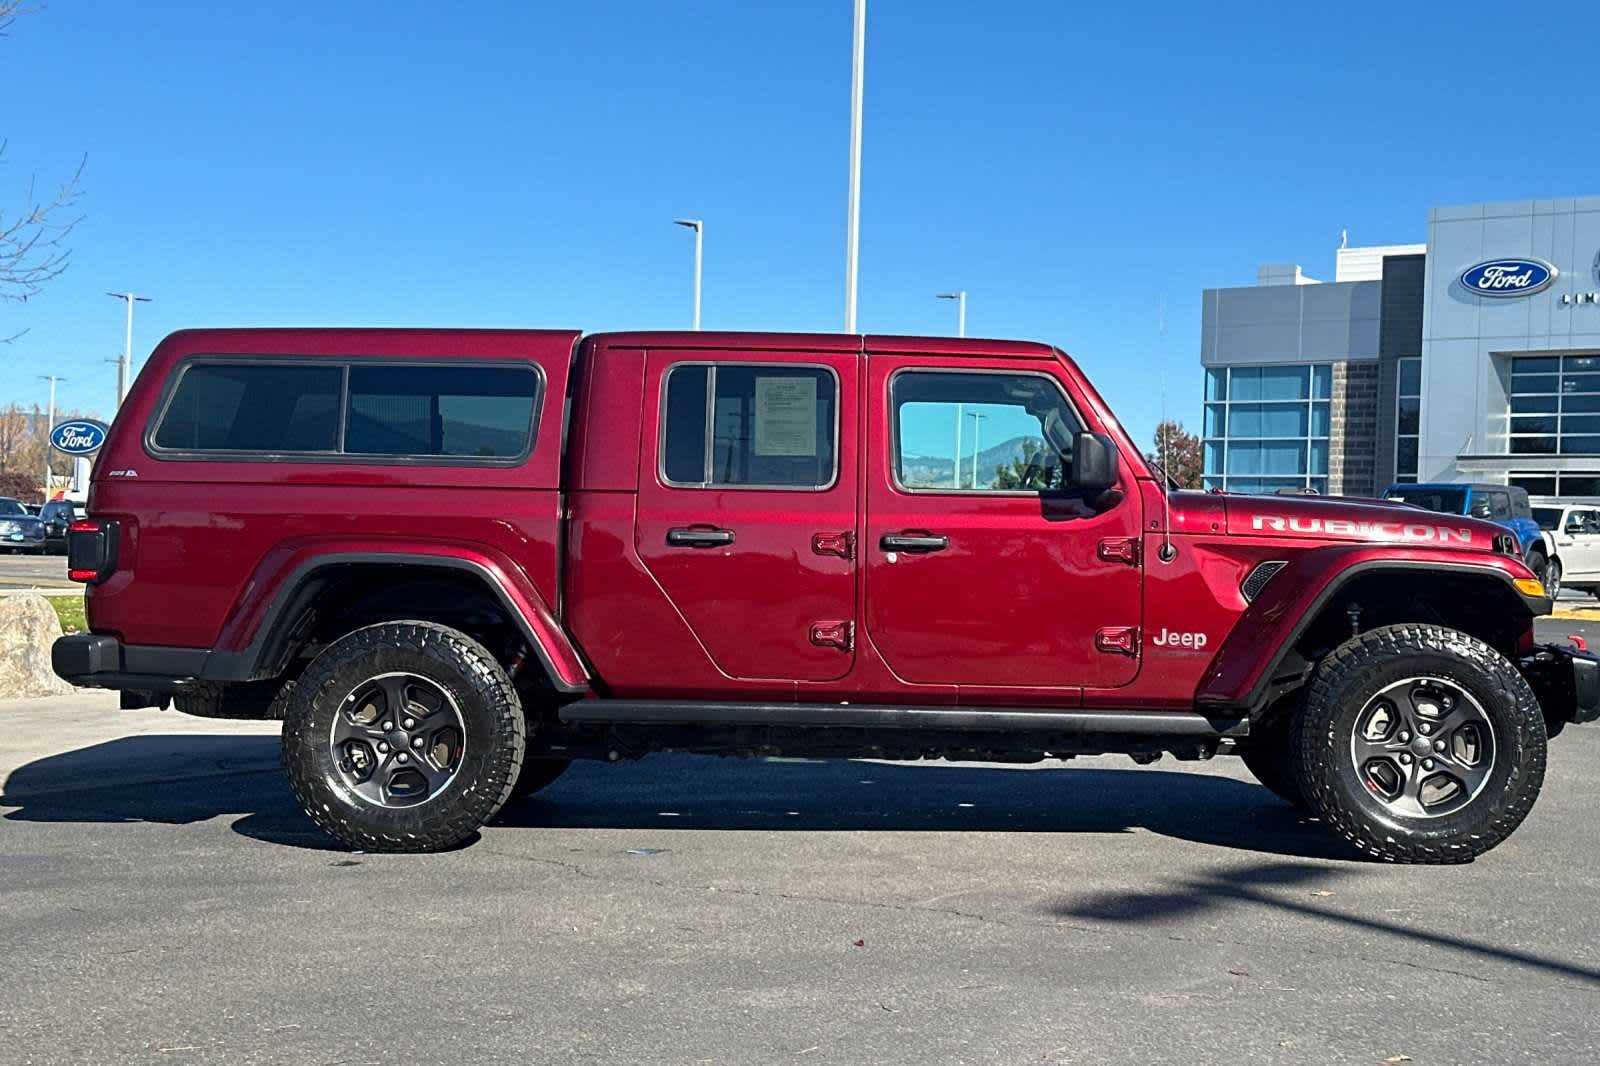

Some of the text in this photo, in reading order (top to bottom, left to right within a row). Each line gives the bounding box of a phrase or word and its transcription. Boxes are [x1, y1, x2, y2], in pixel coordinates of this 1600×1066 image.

[1478, 266, 1533, 288] Ford
[59, 426, 95, 448] Ford
[1252, 514, 1471, 542] RUBICON
[1153, 628, 1207, 650] Jeep
